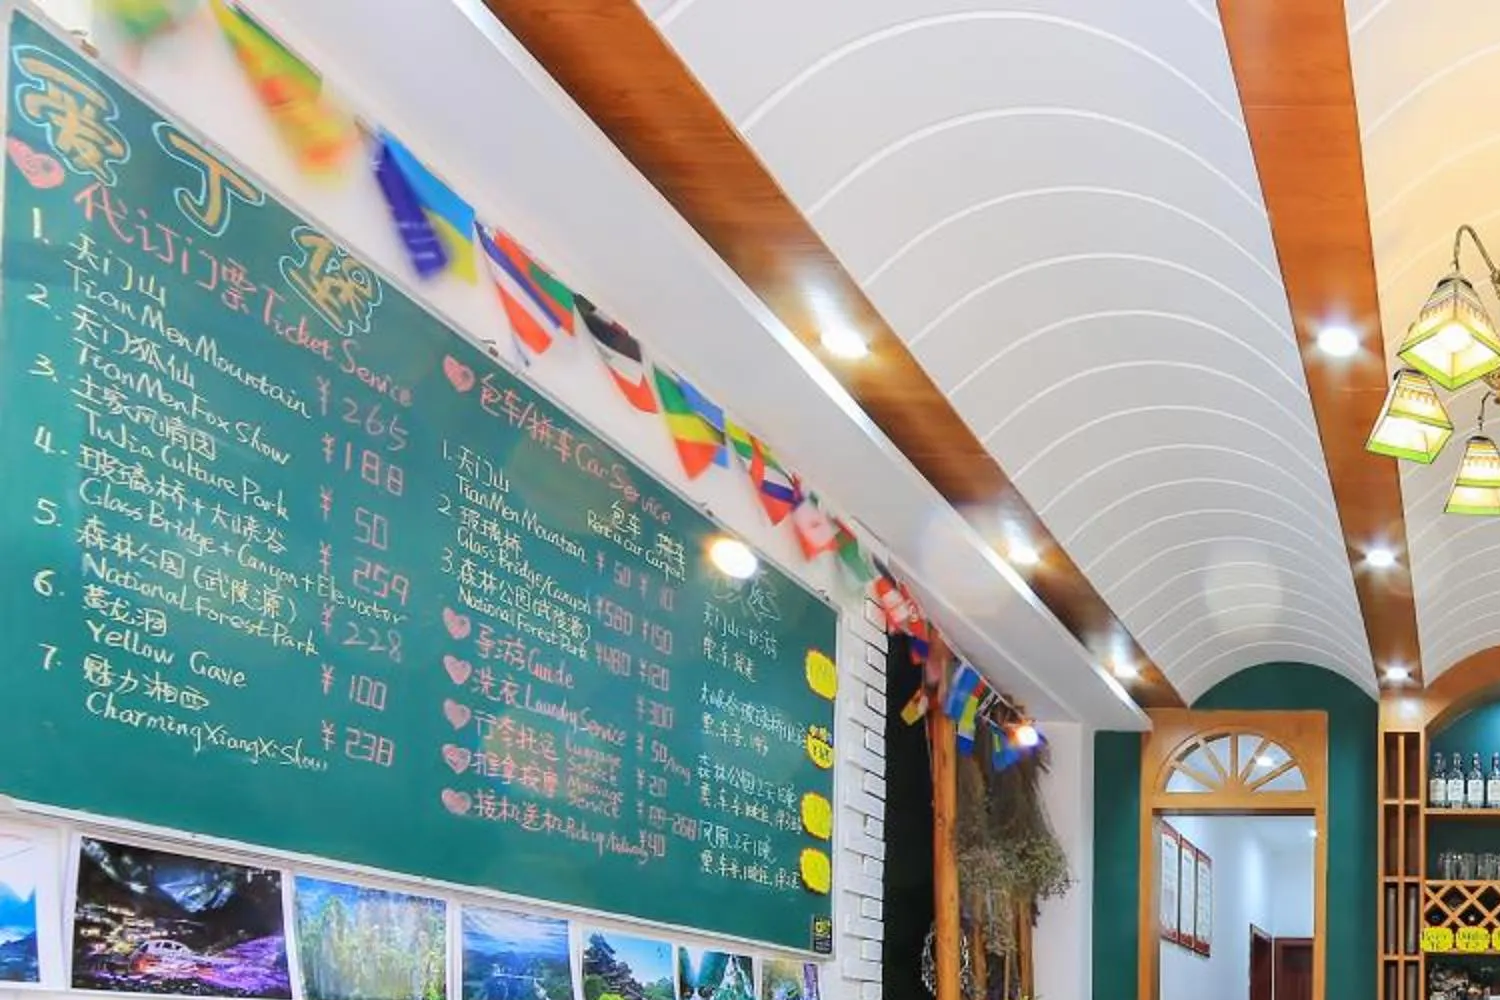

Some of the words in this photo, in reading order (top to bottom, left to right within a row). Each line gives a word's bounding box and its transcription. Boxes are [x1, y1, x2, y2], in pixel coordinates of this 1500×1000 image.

[68, 232, 166, 308] 天门山
[75, 183, 258, 315] 代订门票
[261, 283, 334, 361] Ticket
[71, 303, 195, 389] 天门狐仙
[70, 373, 217, 462] 土家风情园
[458, 444, 510, 494] 天门山
[83, 582, 168, 637] 黄龙洞
[86, 619, 175, 666] Yellow
[82, 652, 211, 711] 魅力湘西
